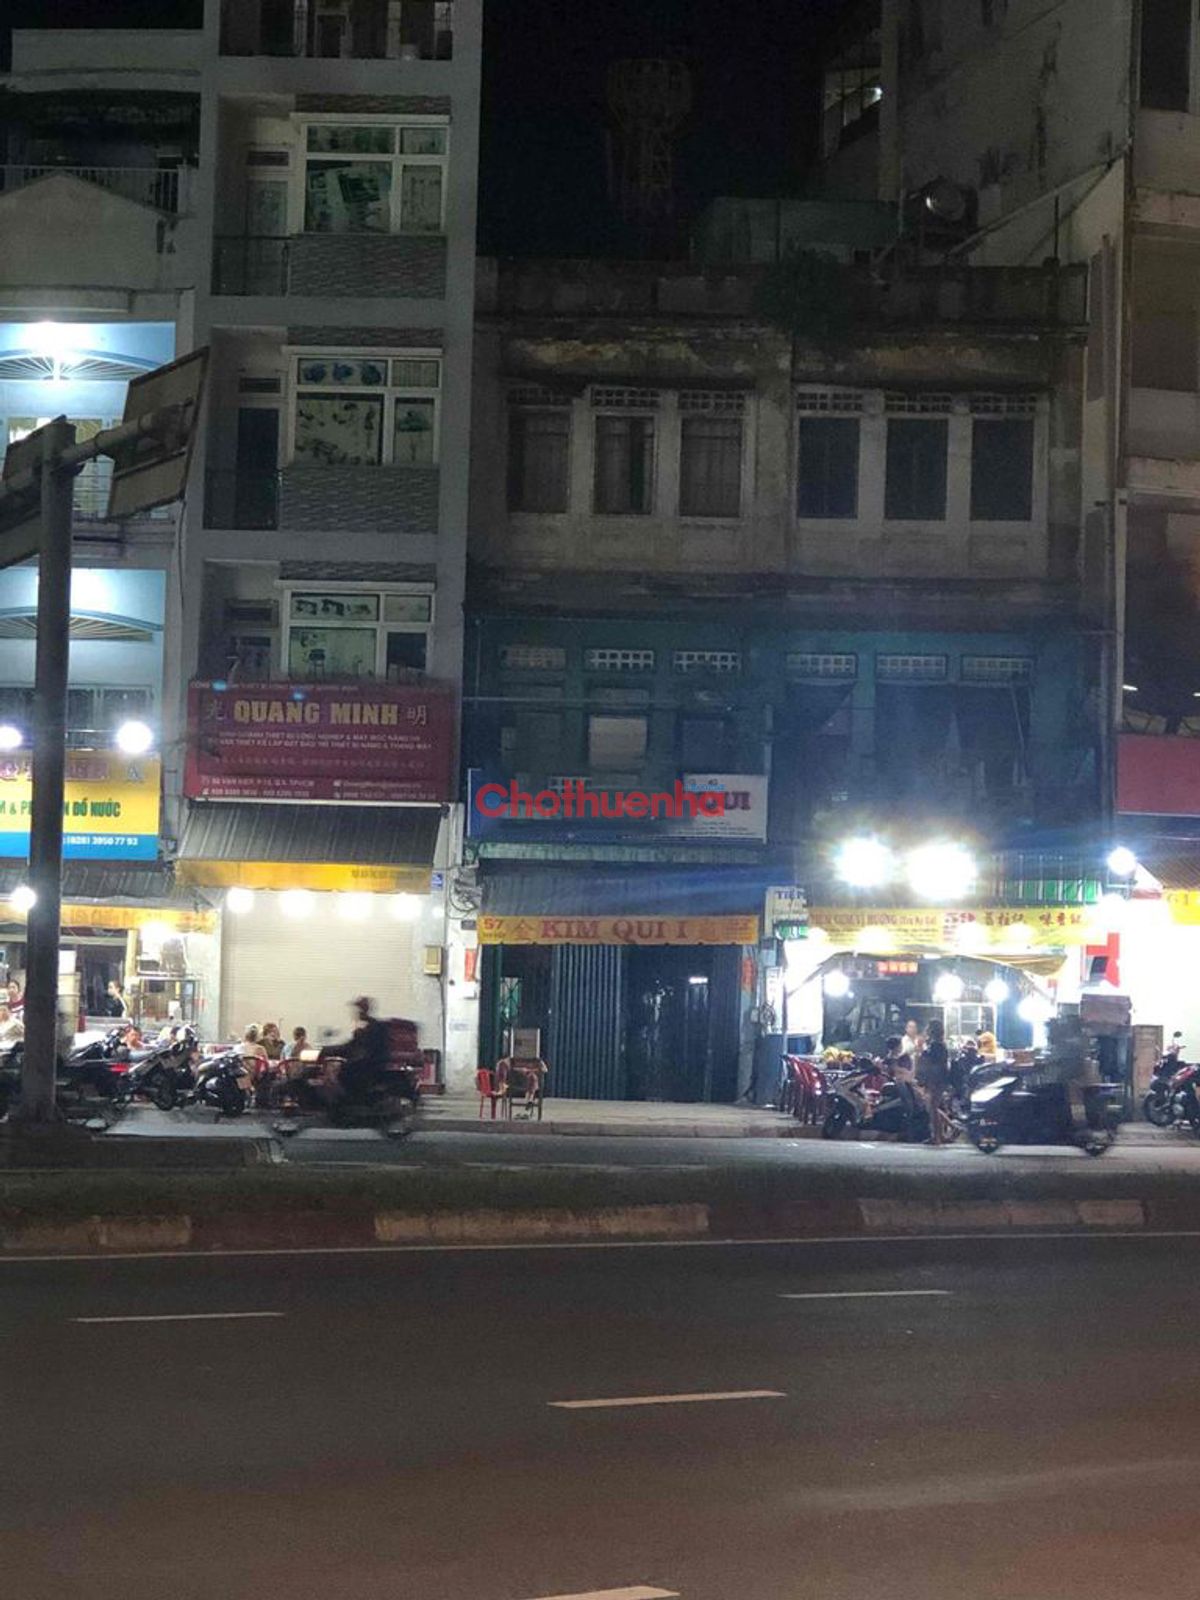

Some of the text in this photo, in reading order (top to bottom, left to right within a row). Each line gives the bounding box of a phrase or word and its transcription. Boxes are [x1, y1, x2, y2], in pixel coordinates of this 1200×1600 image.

[233, 700, 320, 725] QUANG
[330, 702, 399, 726] MINH
[484, 918, 504, 930] 57
[541, 919, 599, 939] KIM
[612, 919, 664, 943] QUI
[675, 920, 688, 939] I
